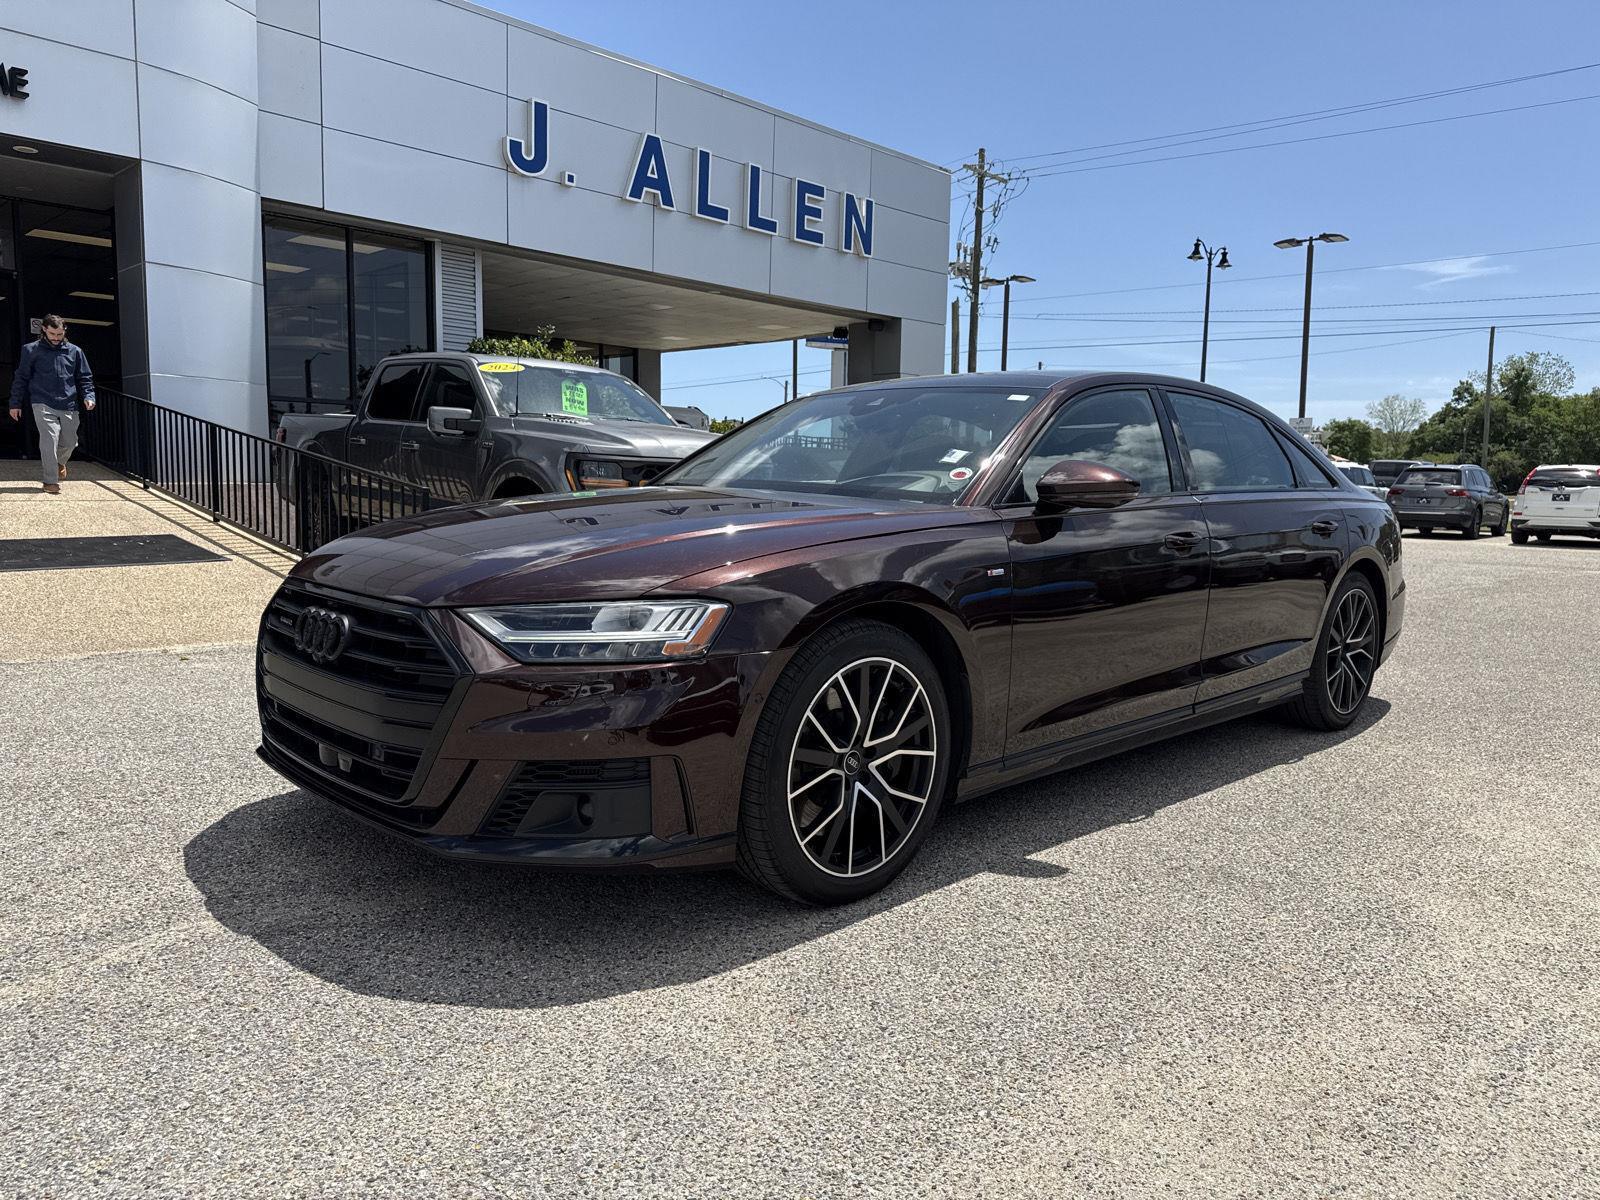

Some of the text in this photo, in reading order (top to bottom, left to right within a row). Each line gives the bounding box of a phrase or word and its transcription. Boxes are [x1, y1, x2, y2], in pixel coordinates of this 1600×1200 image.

[503, 97, 875, 258] J. ALLEN
[487, 363, 517, 371] 2024
[565, 384, 584, 394] WAS
[565, 397, 585, 406] NOW
